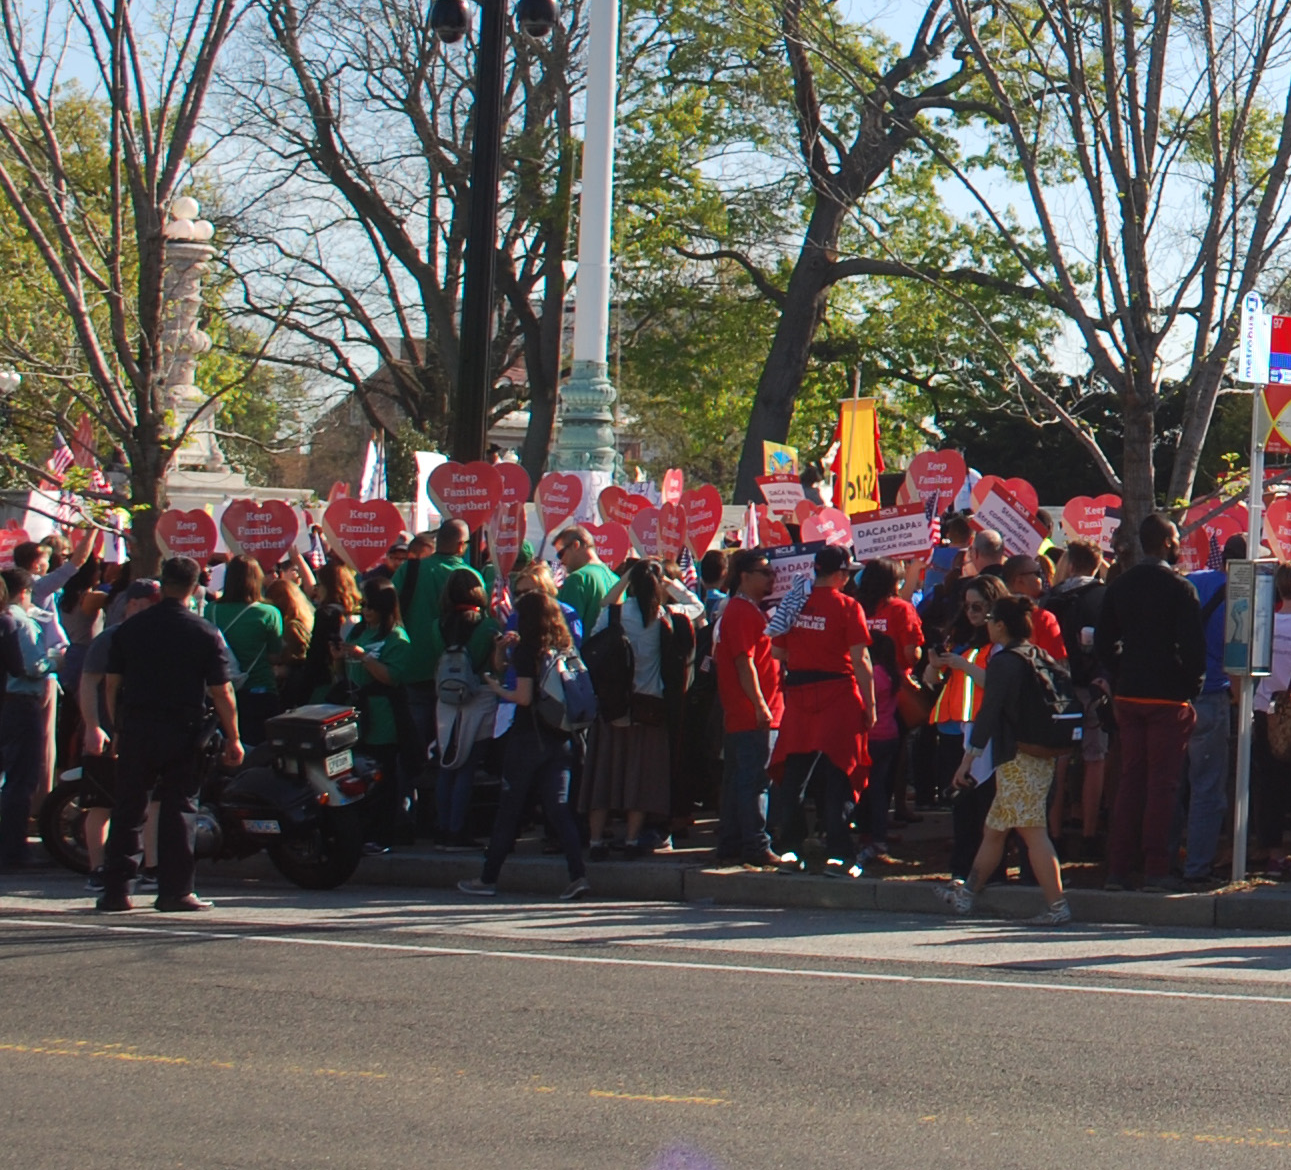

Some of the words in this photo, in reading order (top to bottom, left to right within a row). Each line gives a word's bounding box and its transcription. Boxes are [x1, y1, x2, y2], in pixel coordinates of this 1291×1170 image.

[1246, 315, 1254, 378] metrobus
[452, 474, 478, 484] Keep
[443, 487, 488, 497] Families
[246, 512, 272, 523] Keep
[349, 510, 377, 520] Keep
[1002, 507, 1030, 534] Stronger
[176, 521, 197, 531] Keep
[238, 525, 282, 535] Families
[339, 523, 385, 533] Families
[169, 534, 205, 544] Families
[775, 546, 796, 554] NCLR
